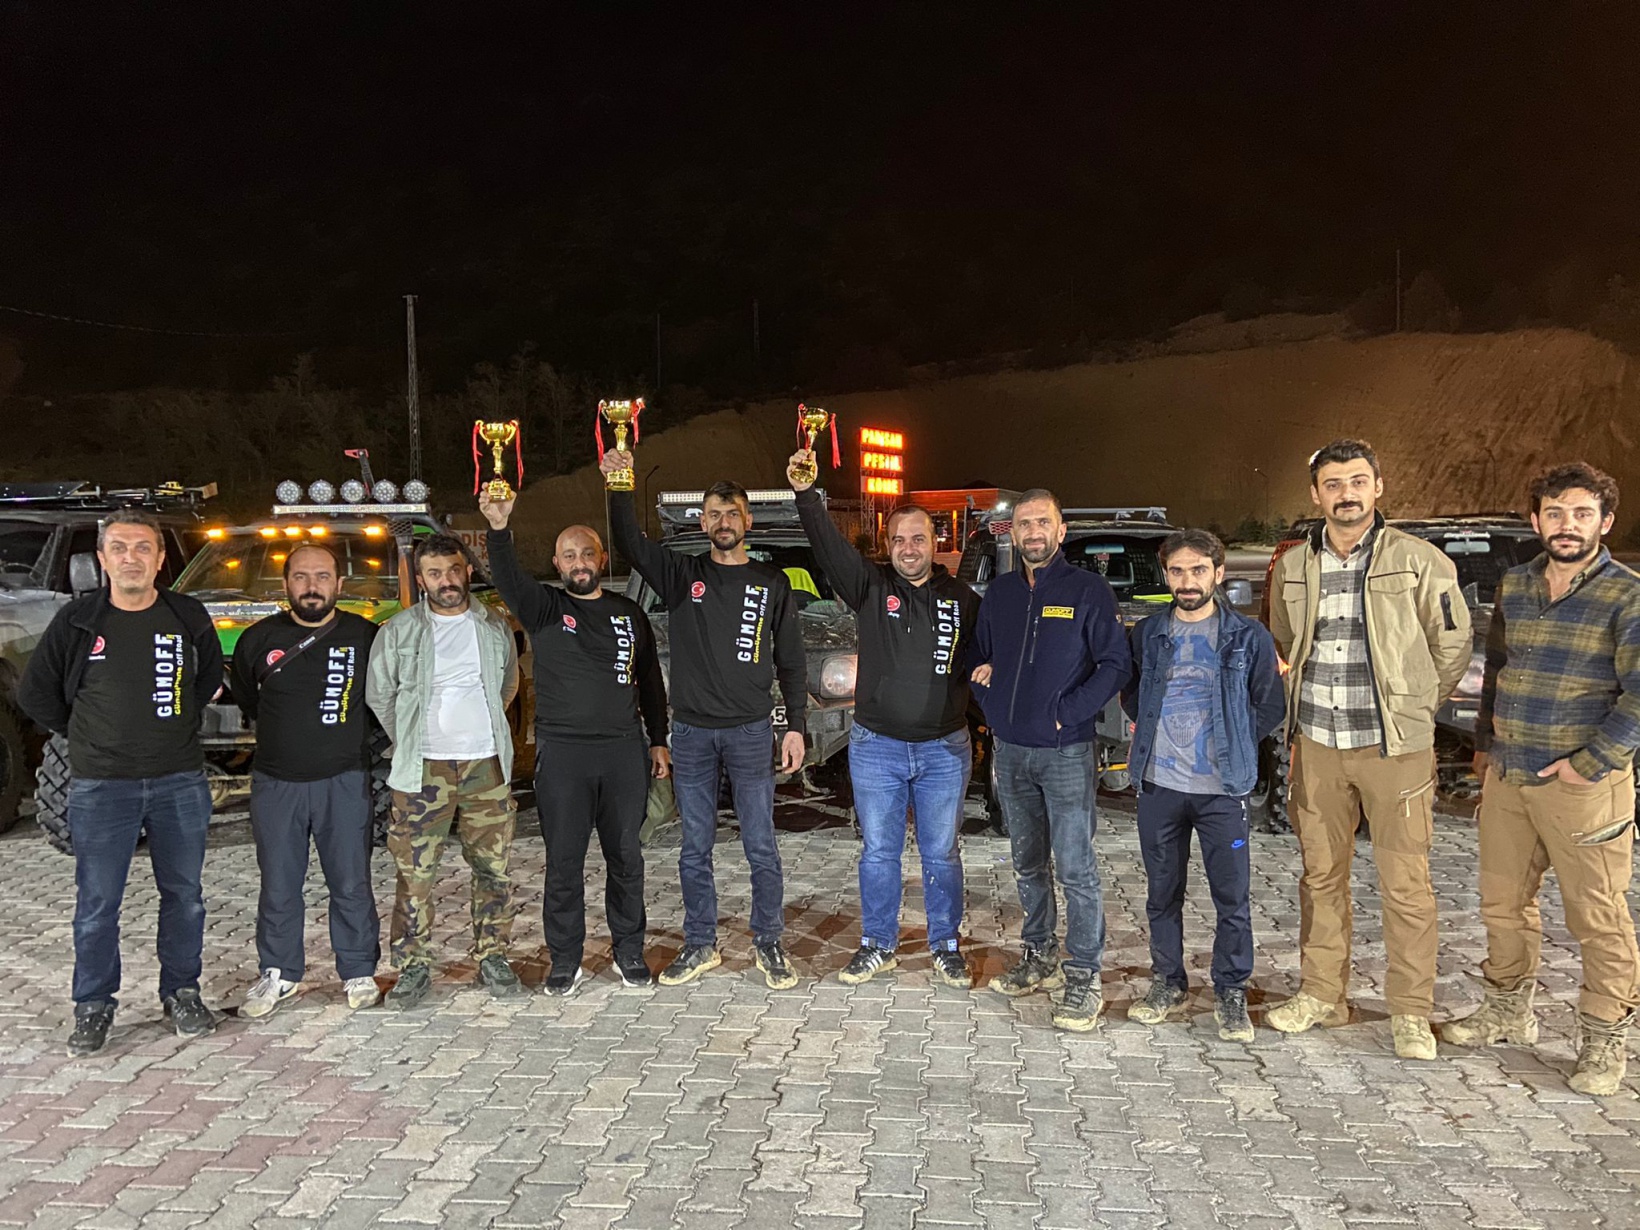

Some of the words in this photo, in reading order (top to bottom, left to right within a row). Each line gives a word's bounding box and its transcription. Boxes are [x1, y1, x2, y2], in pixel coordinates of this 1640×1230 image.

[736, 584, 760, 662] GÜMOFF
[759, 603, 767, 616] Off
[760, 587, 769, 604] Road
[153, 633, 174, 717] GÜMOFF
[610, 615, 630, 684] GÜMOFF
[933, 599, 953, 675] GÜMOFF
[319, 647, 346, 724] GÜMOFF
